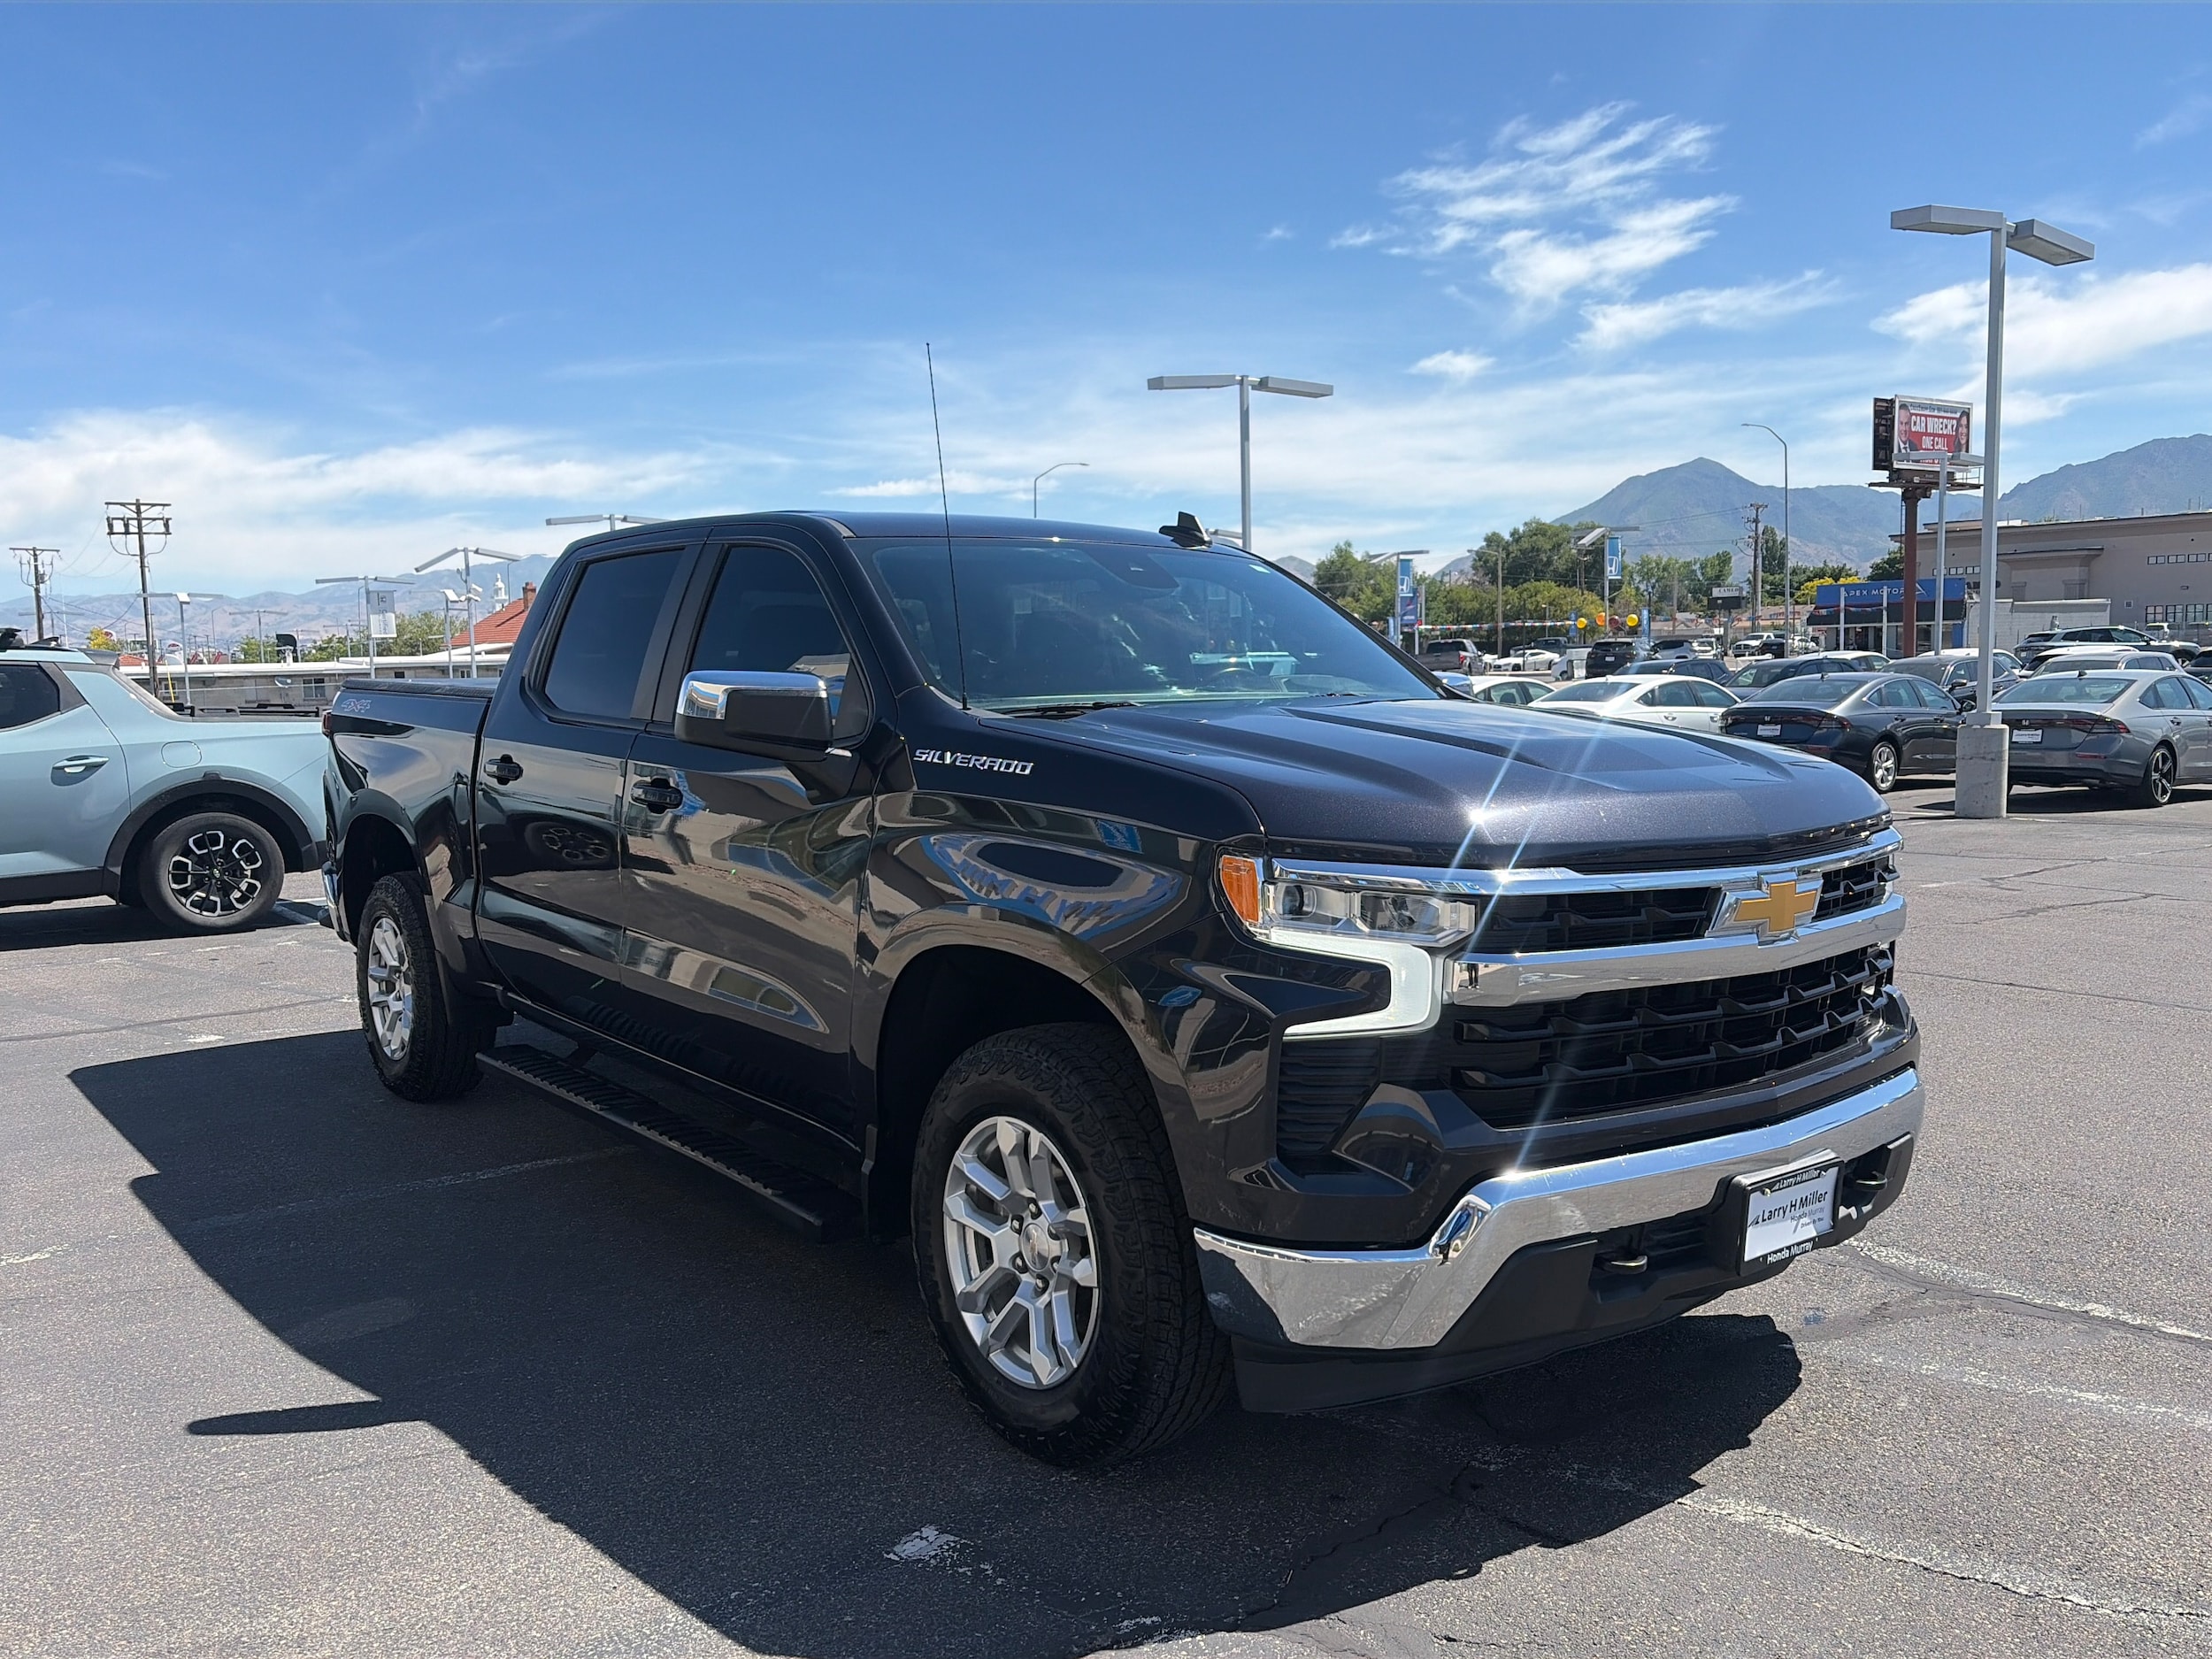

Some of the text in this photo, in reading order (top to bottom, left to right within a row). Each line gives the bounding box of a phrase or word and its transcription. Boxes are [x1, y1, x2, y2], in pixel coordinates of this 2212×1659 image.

[1911, 415, 1957, 435] CAR WRECK?
[1922, 435, 1948, 450] ONE CALL
[1843, 588, 1868, 598] APEX
[913, 748, 1034, 775] SILVERADO
[1779, 1169, 1821, 1189] Larry H Miller
[1762, 1190, 1828, 1222] Larry H Miller
[1790, 1206, 1825, 1223] Honda Murray
[1767, 1240, 1814, 1264] Honda Murray
